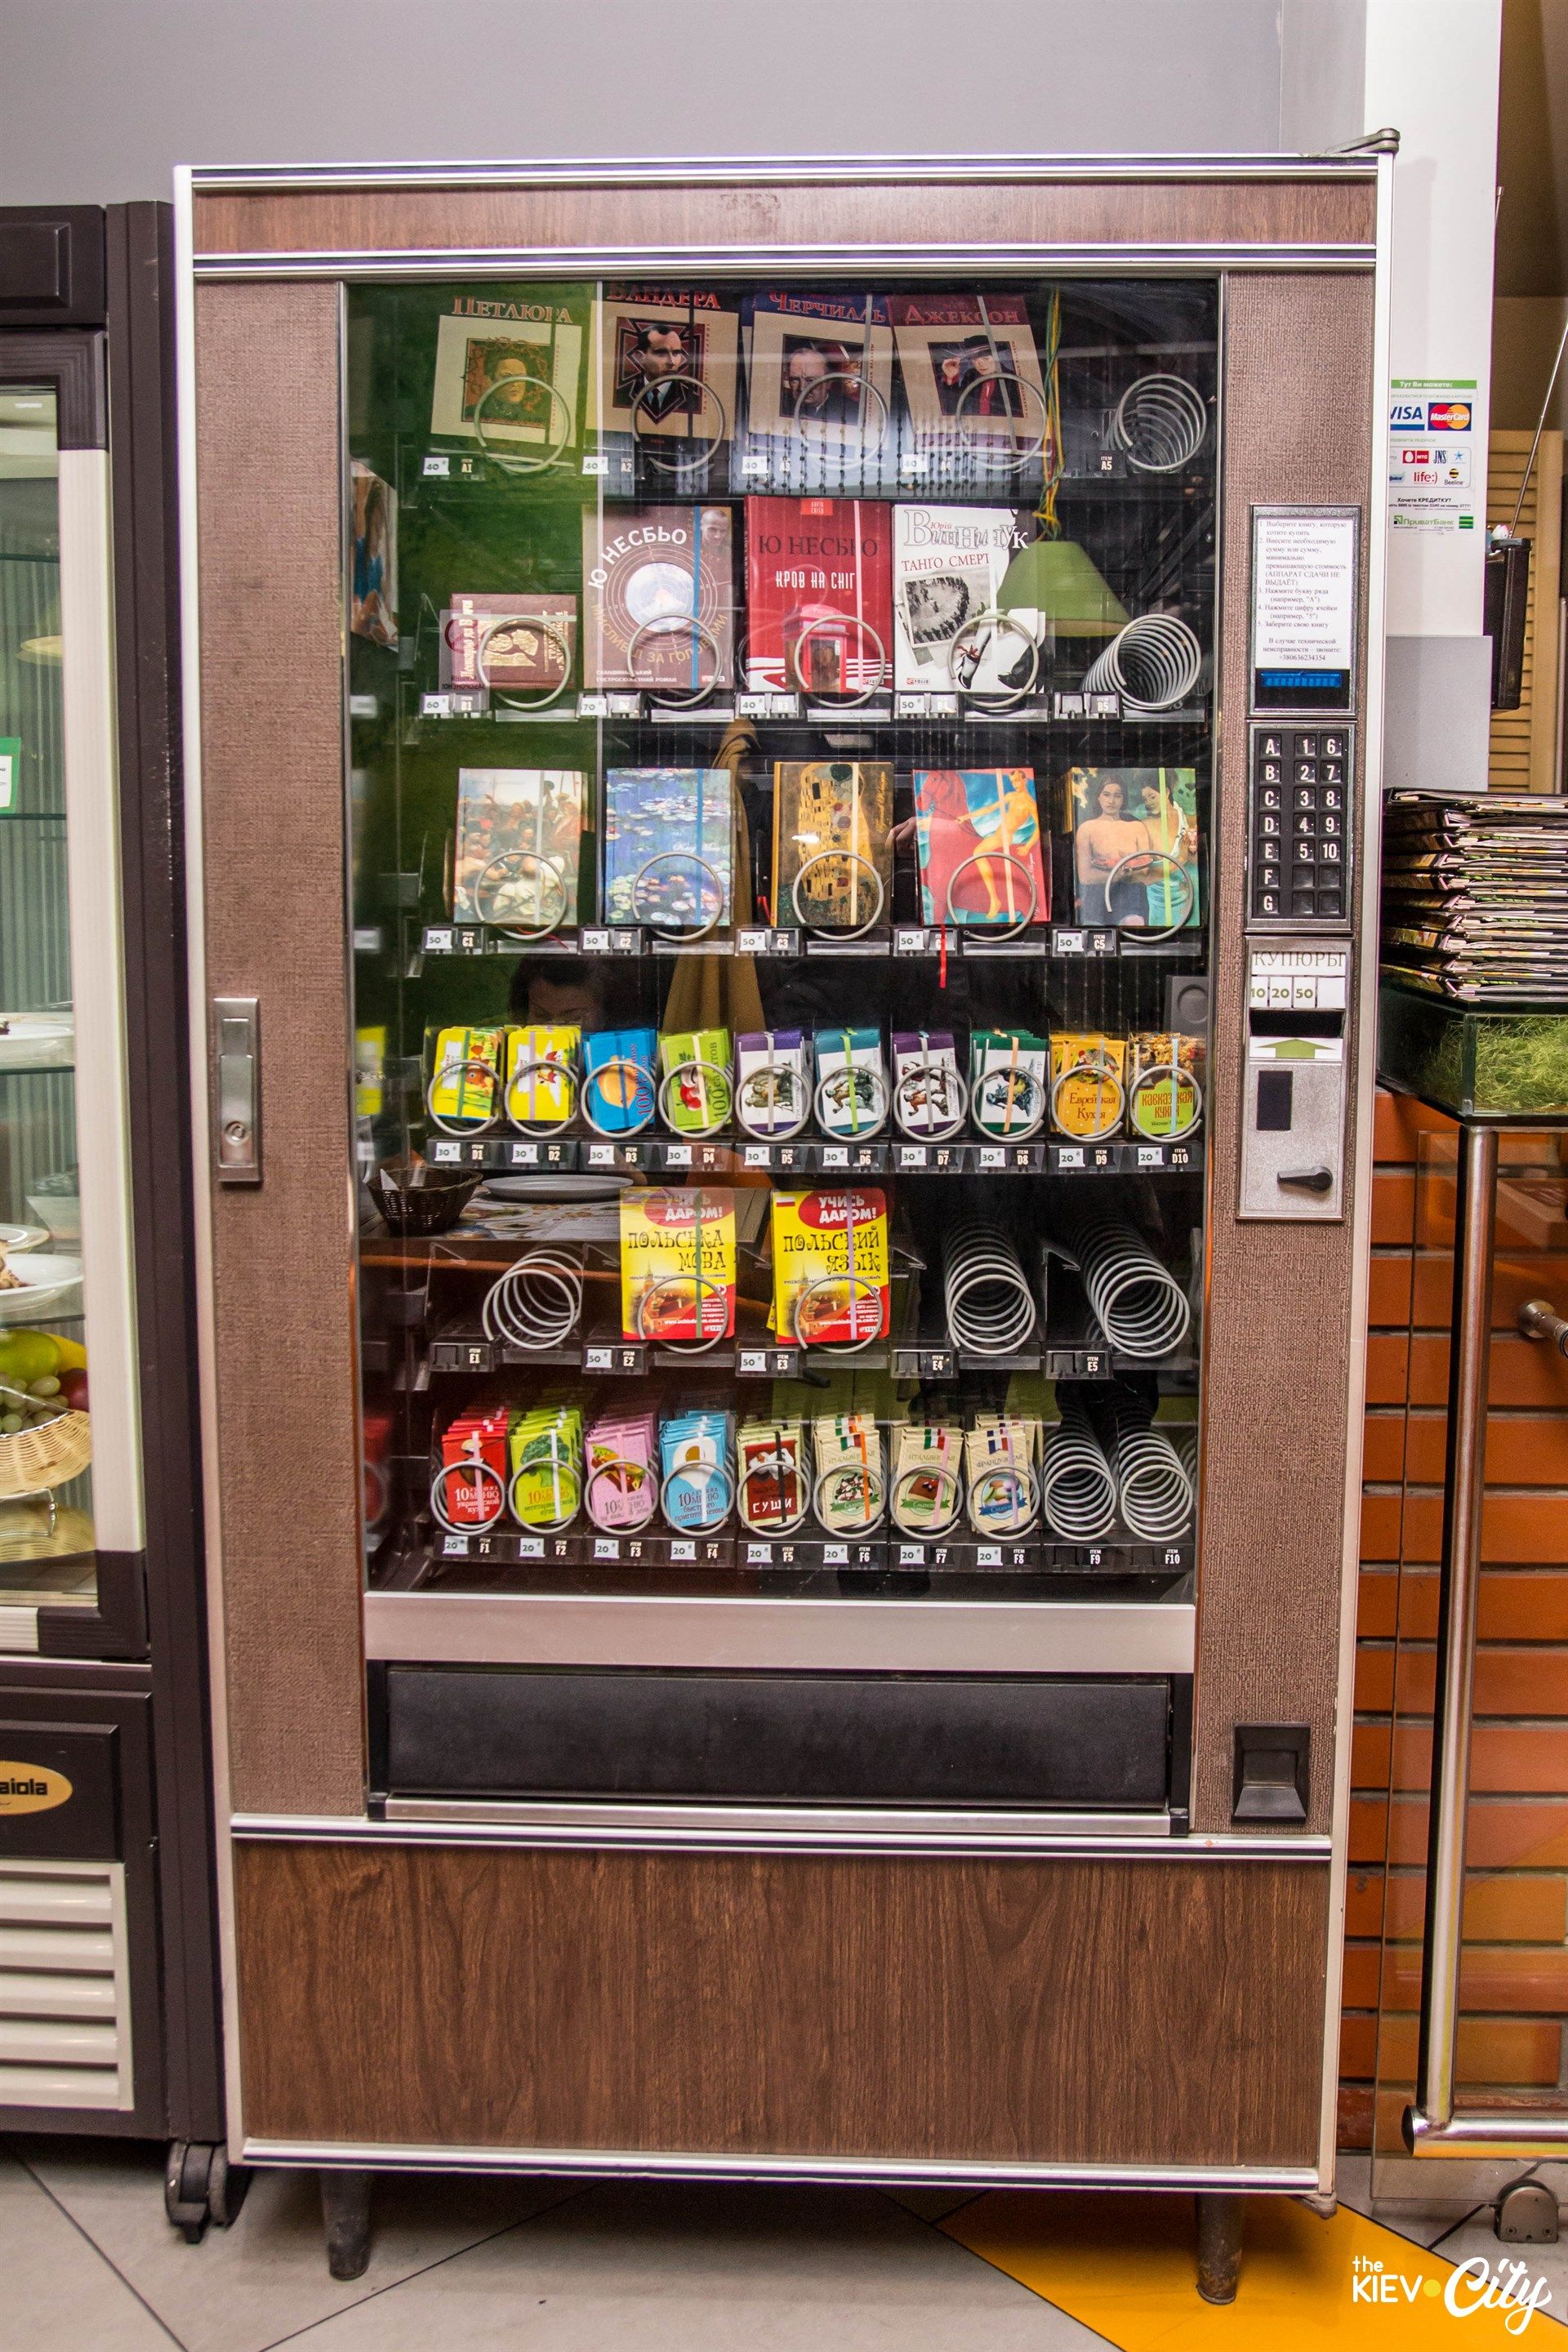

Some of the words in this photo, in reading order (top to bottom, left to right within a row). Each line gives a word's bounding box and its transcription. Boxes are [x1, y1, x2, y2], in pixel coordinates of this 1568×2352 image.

[1430, 412, 1469, 421] MasterCard
[1100, 461, 1112, 471] A5
[1414, 470, 1438, 484] life:)
[930, 521, 953, 530] Юрій
[759, 535, 782, 555] Ю
[788, 536, 879, 558] НЕСБЬО
[586, 568, 609, 590] Ю
[600, 526, 688, 566] НЕСБЬО
[949, 553, 990, 568] СМЕРТ
[776, 570, 805, 589] КРОВ
[810, 572, 826, 589] НА
[831, 572, 856, 590] СНІГ
[1303, 571, 1329, 579] СДАЧИ
[459, 599, 474, 626] Внчи
[426, 701, 439, 710] 60
[583, 702, 596, 711] 70
[742, 701, 756, 710] 40
[902, 701, 915, 709] 50
[1265, 739, 1275, 754] A
[1303, 739, 1308, 754] 1
[1327, 739, 1335, 754] 6
[1266, 765, 1275, 780] B
[1300, 765, 1309, 781] 2
[1327, 765, 1335, 780] 7
[1265, 791, 1274, 806] C
[1300, 791, 1308, 806] 3
[1326, 791, 1334, 806] 8
[1264, 817, 1274, 832] D
[1299, 817, 1308, 832] 4
[1325, 817, 1334, 833] 9
[1265, 844, 1273, 858] E
[1299, 844, 1308, 858] 5
[1322, 844, 1337, 858] 10
[1264, 870, 1272, 884] F
[1263, 896, 1273, 911] G
[429, 936, 441, 944] 50
[742, 938, 755, 946] 50
[900, 937, 913, 945] 50
[1094, 939, 1106, 950] C5
[1254, 951, 1343, 968] КУПЮРЫ
[1250, 987, 1266, 999] 10
[1272, 987, 1290, 999] 20
[1295, 987, 1314, 1000] 50
[635, 1086, 654, 1116] 100
[711, 1089, 728, 1118] 100
[1070, 1093, 1116, 1106] Еврейкая
[438, 1148, 450, 1156] 30
[471, 1150, 483, 1160] D1
[514, 1150, 527, 1158] 30
[548, 1151, 560, 1161] D2
[626, 1152, 638, 1163] D3
[747, 1152, 760, 1160] 30
[1140, 1153, 1153, 1161] 20
[702, 1153, 715, 1164] D4
[782, 1154, 793, 1165] D5
[860, 1155, 871, 1165] D6
[938, 1155, 949, 1165] D7
[1017, 1155, 1029, 1165] D8
[1096, 1155, 1107, 1165] D9
[1172, 1153, 1189, 1164] D10
[665, 1206, 723, 1222] ДАРОМ!
[819, 1207, 877, 1223] ДАРОМ!
[679, 1251, 726, 1272] МОВА
[826, 1252, 880, 1275] ЯЗЫК
[589, 1355, 601, 1363] 50
[932, 1361, 943, 1371] E4
[1087, 1361, 1098, 1372] E5
[454, 1487, 470, 1502] 10
[528, 1490, 541, 1504] 10
[679, 1493, 692, 1507] 10
[605, 1500, 617, 1516] 10
[753, 1498, 792, 1514] СУШИ
[445, 1541, 457, 1549] 20
[479, 1543, 490, 1553] F1
[555, 1545, 567, 1556] F2
[597, 1545, 609, 1553] 20
[630, 1547, 641, 1557] F3
[707, 1548, 718, 1559] F4
[750, 1550, 762, 1558] 20
[783, 1551, 794, 1562] F5
[826, 1550, 838, 1558] 20
[859, 1551, 870, 1562] F6
[902, 1551, 915, 1559] 20
[979, 1552, 992, 1561] 20
[936, 1553, 947, 1564] F7
[1013, 1553, 1024, 1565] F8
[1090, 1554, 1101, 1565] F9
[1165, 1554, 1181, 1564] F10
